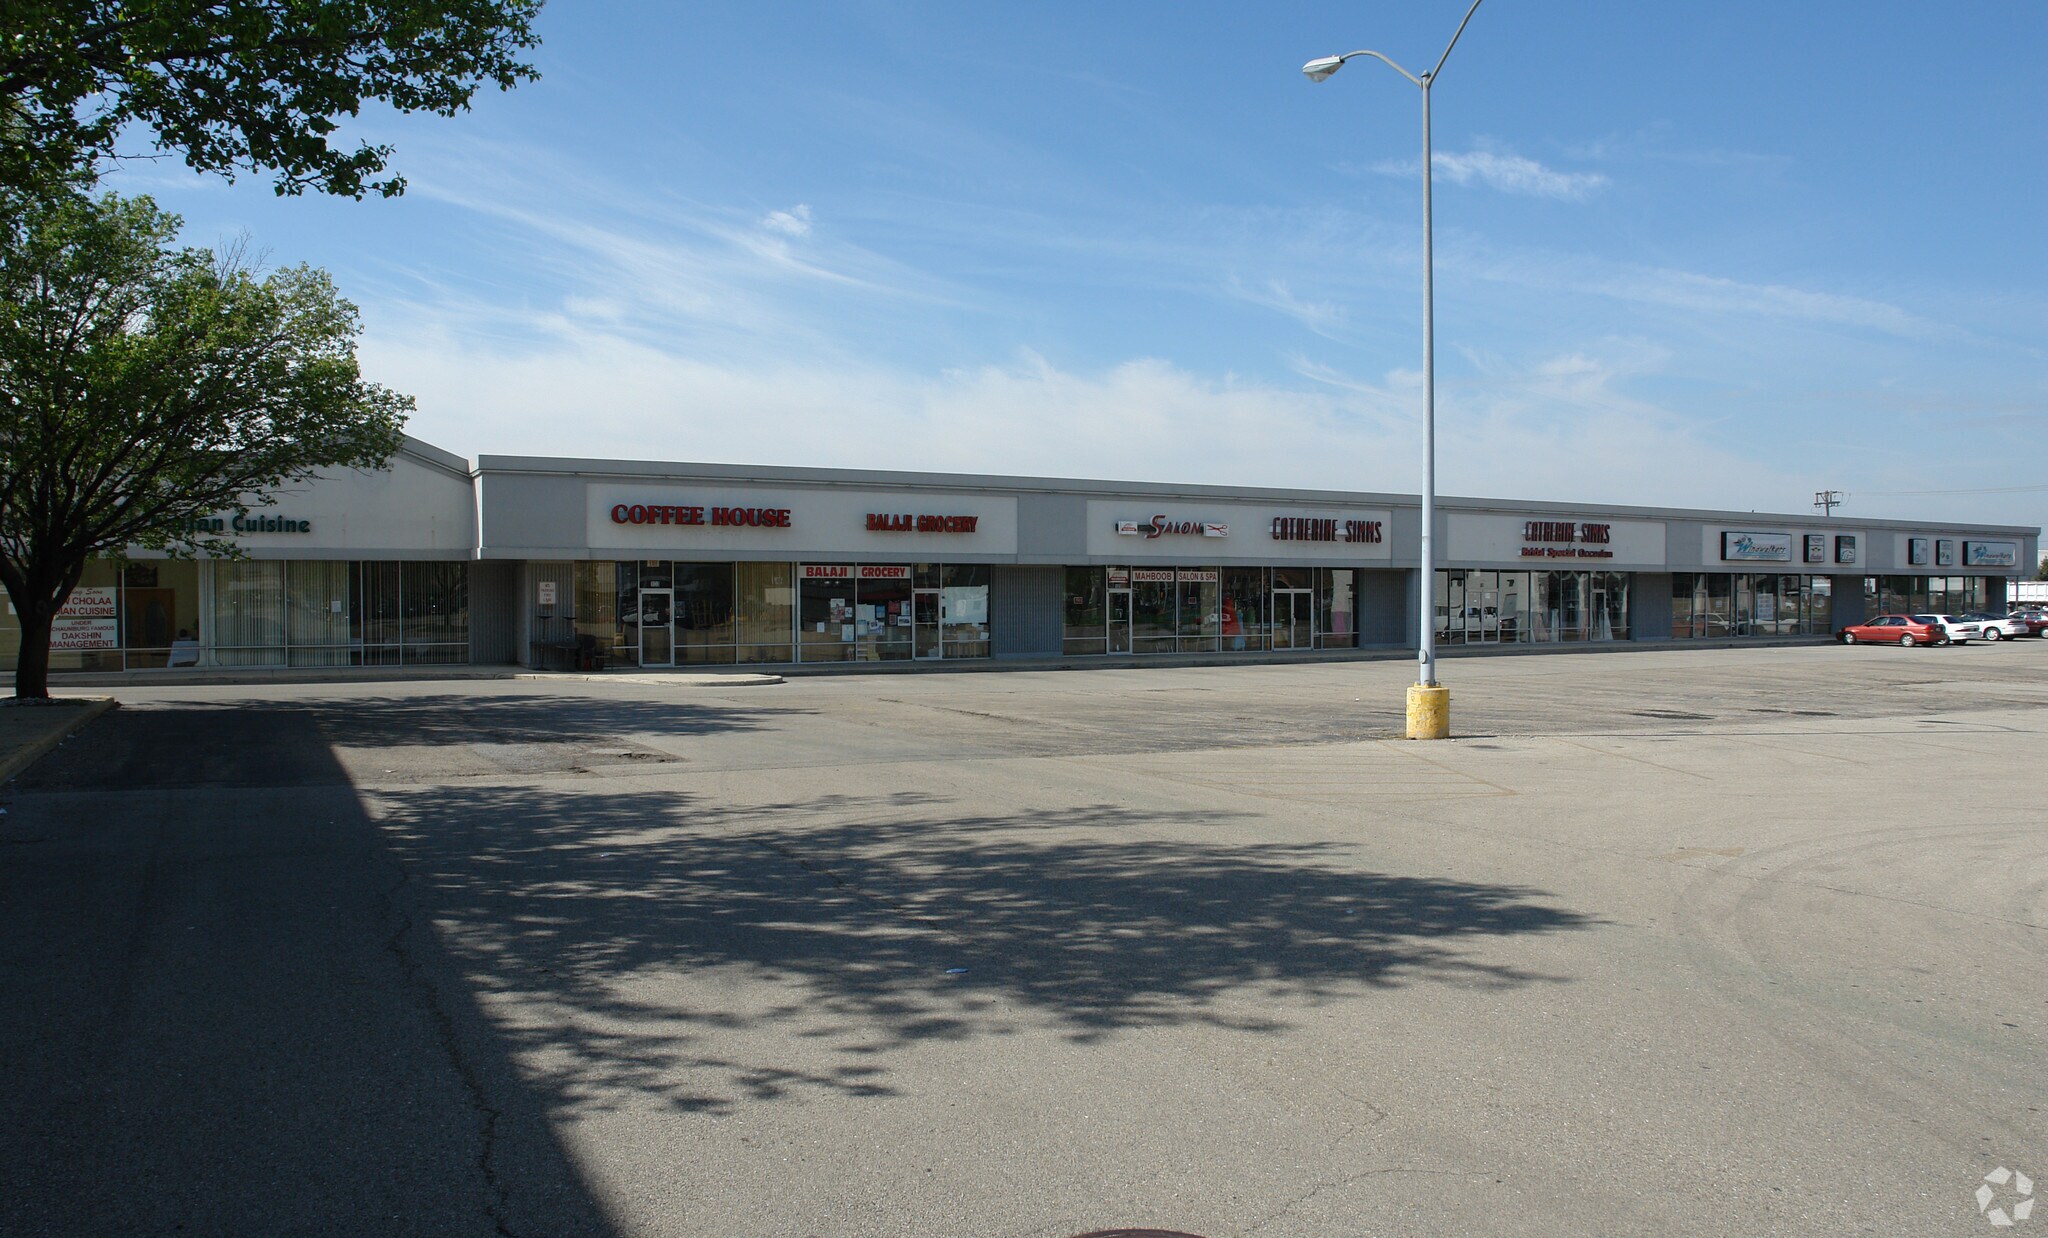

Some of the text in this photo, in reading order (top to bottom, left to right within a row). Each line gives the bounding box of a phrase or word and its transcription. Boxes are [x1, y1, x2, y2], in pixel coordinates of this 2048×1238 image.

[611, 504, 791, 527] COFFEE HOUSE
[231, 514, 311, 533] Cuisine
[866, 513, 978, 533] BALAJI GROCERY
[1272, 516, 1382, 543] CATHERINE SIMMS
[1525, 521, 1610, 543] CATHERINE SIMMS
[805, 566, 906, 577] BALAJI GROCERY
[1134, 572, 1217, 581] MAHBOOB SALON & SPA
[72, 597, 112, 605] CHOLAA
[78, 607, 115, 615] CUISINE
[61, 632, 102, 640] DAKSHIN
[49, 640, 114, 648] MANAGEMENT
